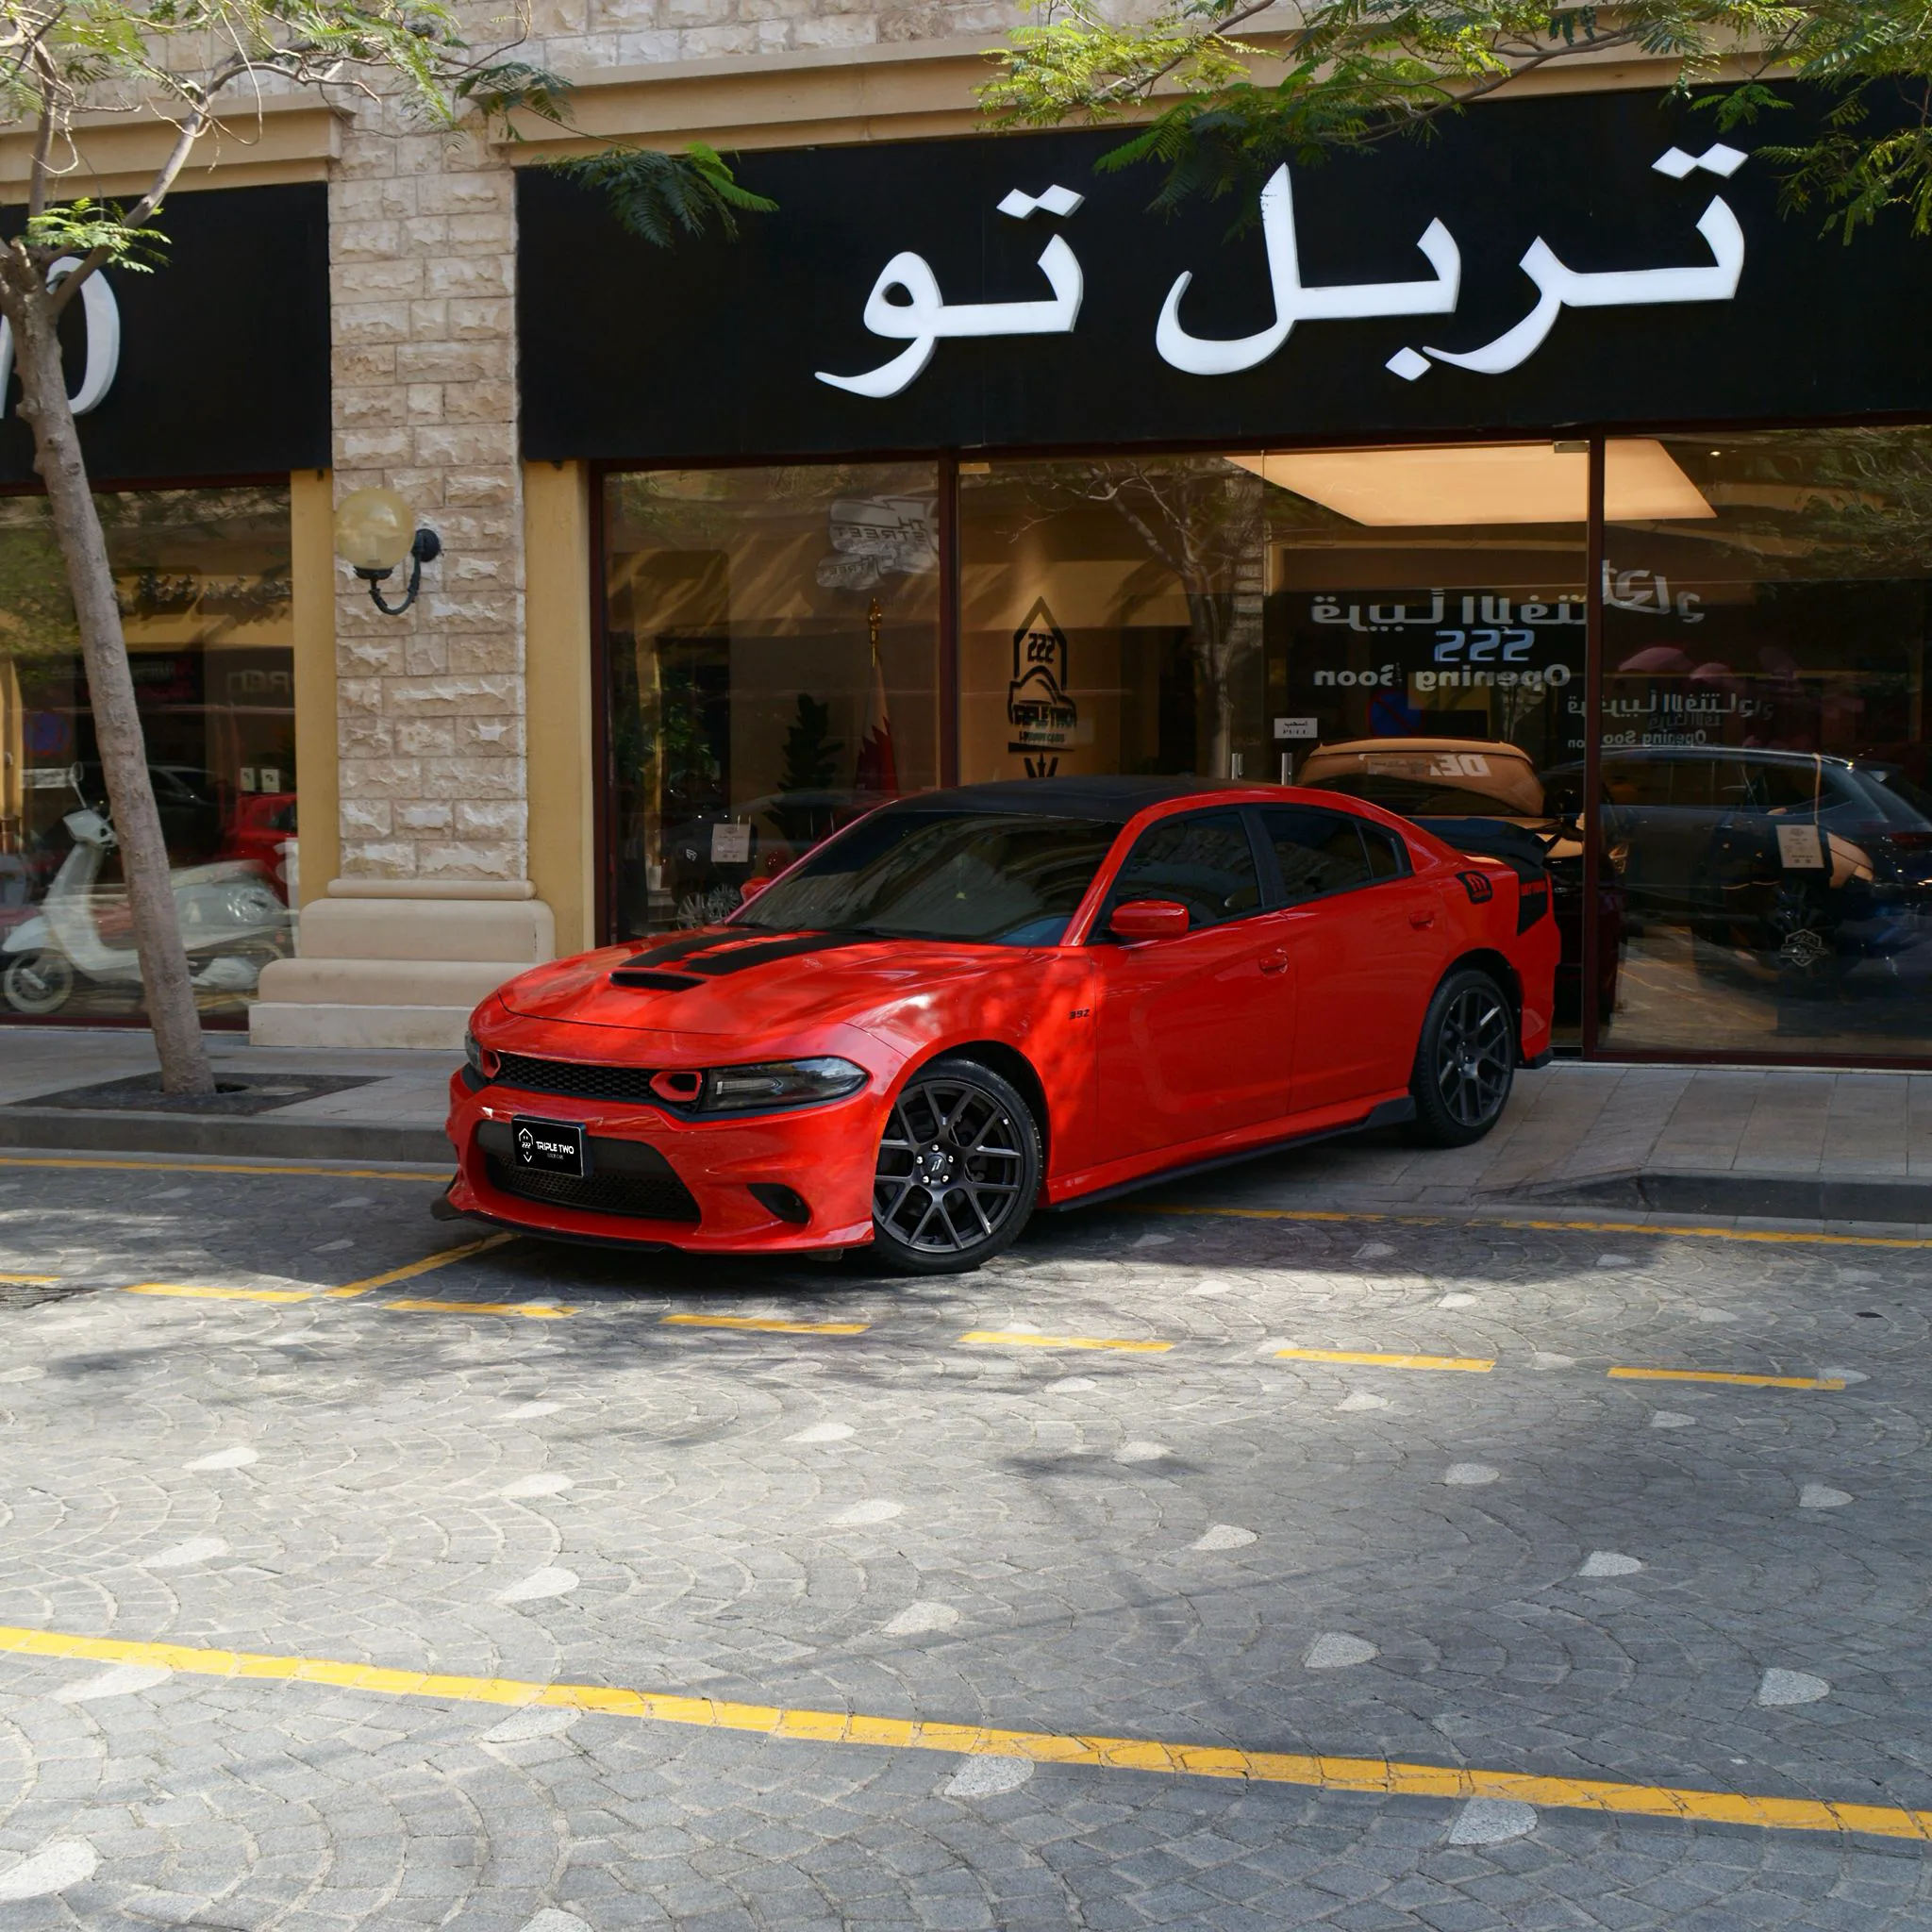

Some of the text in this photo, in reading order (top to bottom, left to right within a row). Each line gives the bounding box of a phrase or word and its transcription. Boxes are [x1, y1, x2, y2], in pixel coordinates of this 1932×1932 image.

[815, 184, 1085, 398] تو
[1027, 633, 1056, 663] 222
[536, 1141, 575, 1155] TRIPLE TWO
